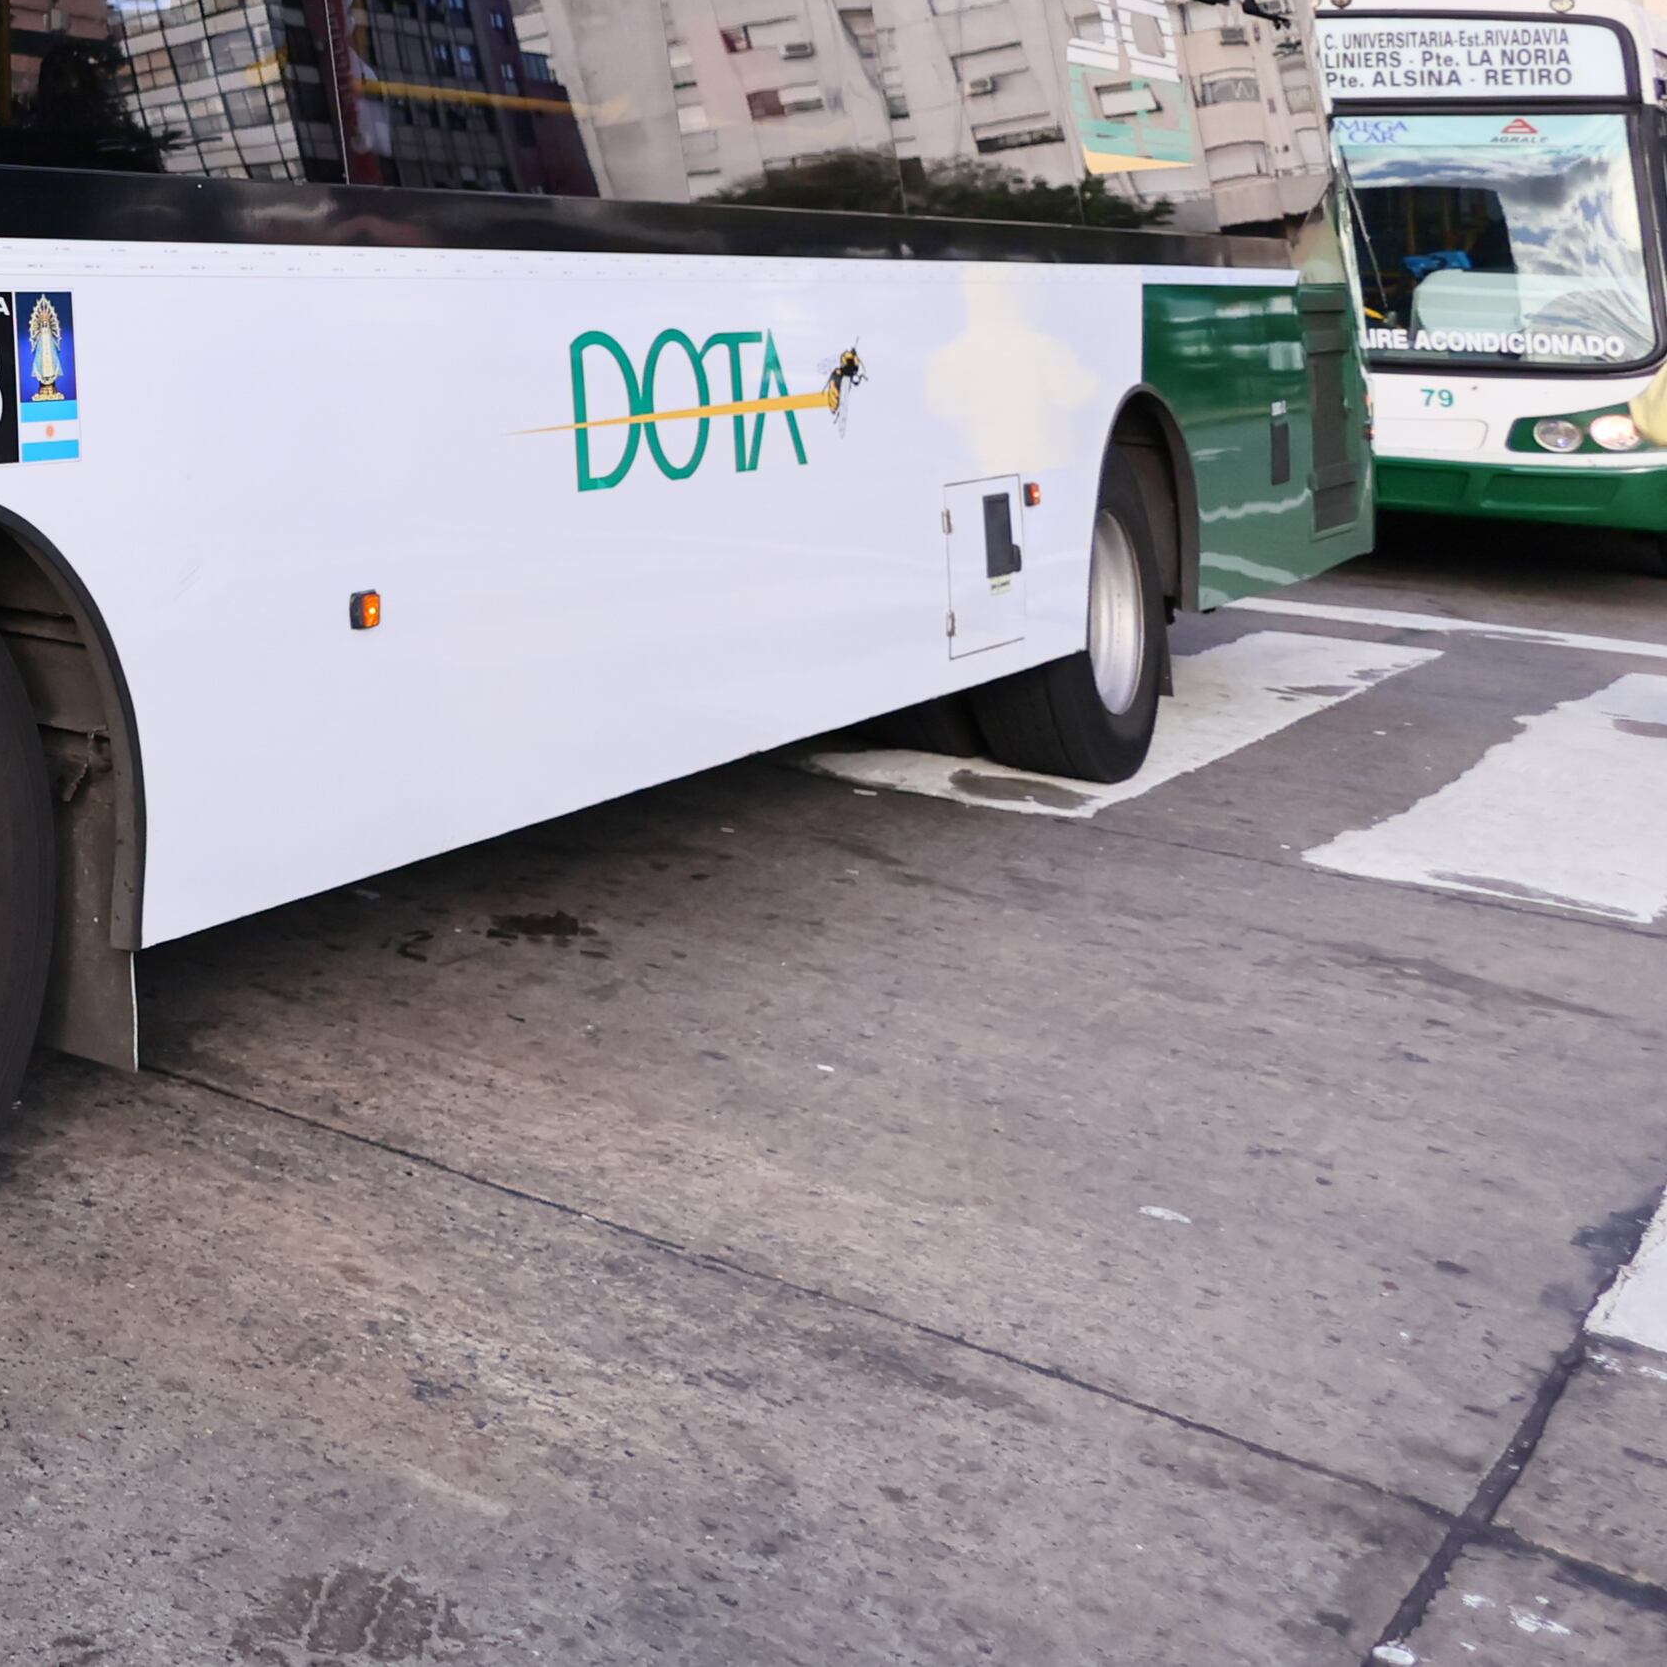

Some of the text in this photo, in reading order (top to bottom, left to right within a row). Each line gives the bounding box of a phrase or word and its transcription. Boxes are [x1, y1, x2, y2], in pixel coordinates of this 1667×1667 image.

[1324, 34, 1338, 50] C.
[1324, 51, 1402, 69] LINIERS
[1422, 51, 1460, 67] Pte.
[1467, 50, 1493, 66] LA
[1501, 49, 1571, 66] NORIA
[1325, 72, 1364, 88] Pte.
[1372, 70, 1462, 87] ALSINA
[1485, 68, 1572, 85] RETIRO
[1415, 331, 1626, 357] ACONDICIONADO
[1420, 389, 1455, 408] 79
[570, 328, 808, 492] DOTA
